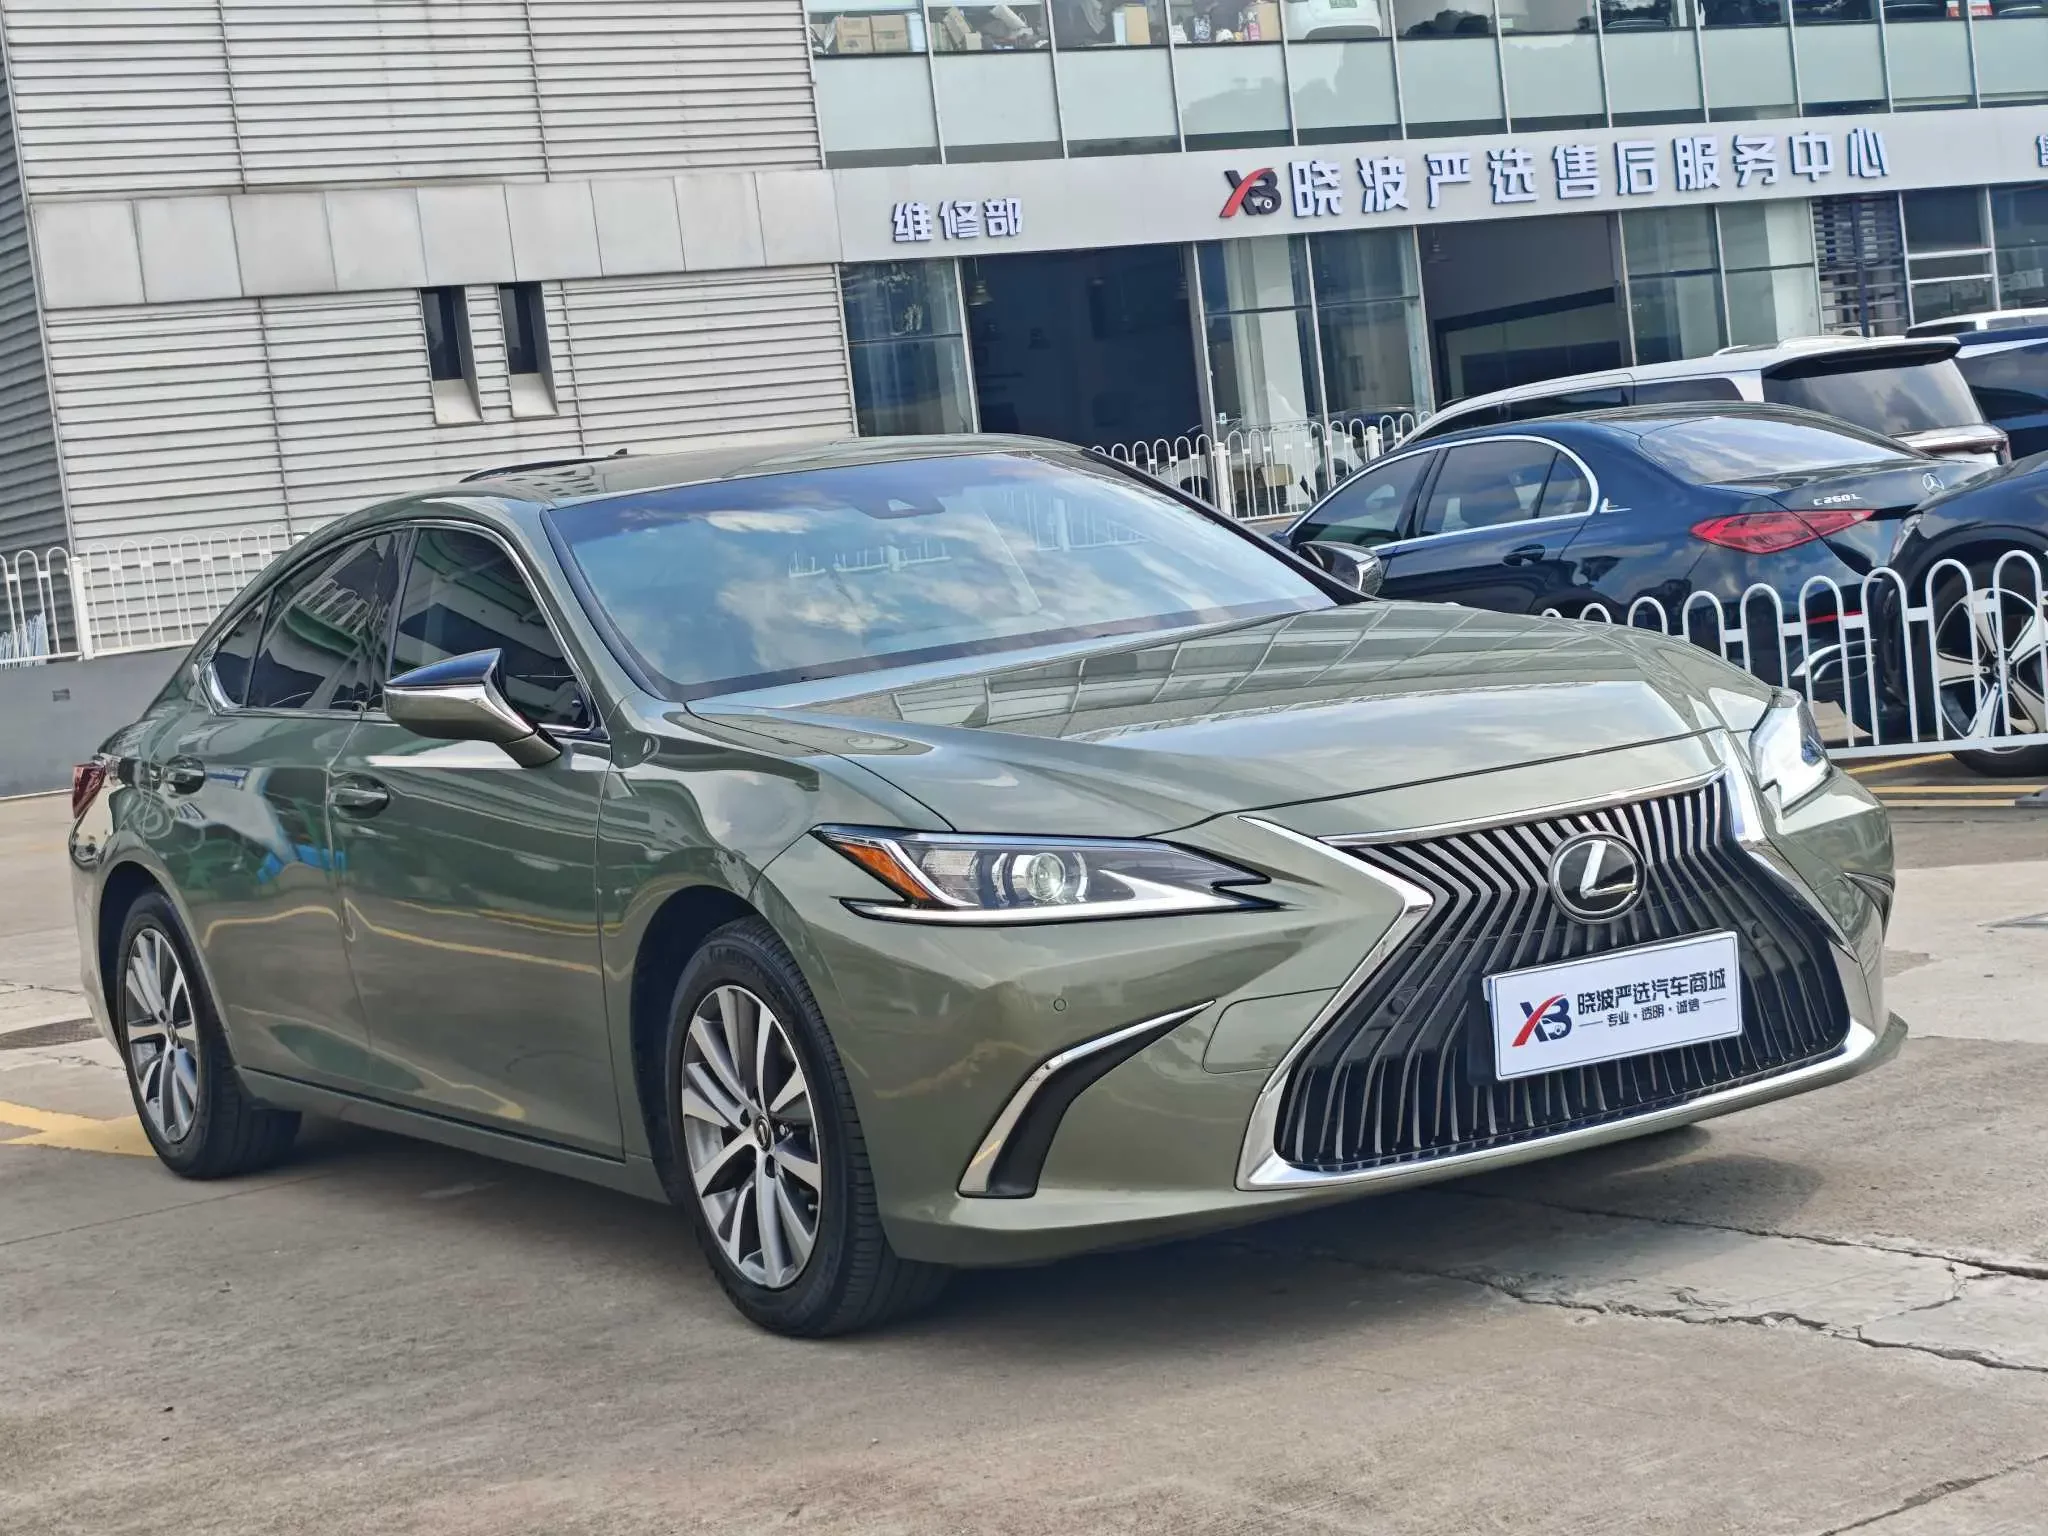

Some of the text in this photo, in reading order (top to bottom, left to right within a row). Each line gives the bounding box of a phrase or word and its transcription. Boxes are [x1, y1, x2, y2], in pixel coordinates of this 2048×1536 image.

[1290, 128, 1889, 217] 晓波严选售后服务中心
[892, 198, 1022, 242] 维修部
[1577, 968, 1726, 1015] 晓波严选汽车商城
